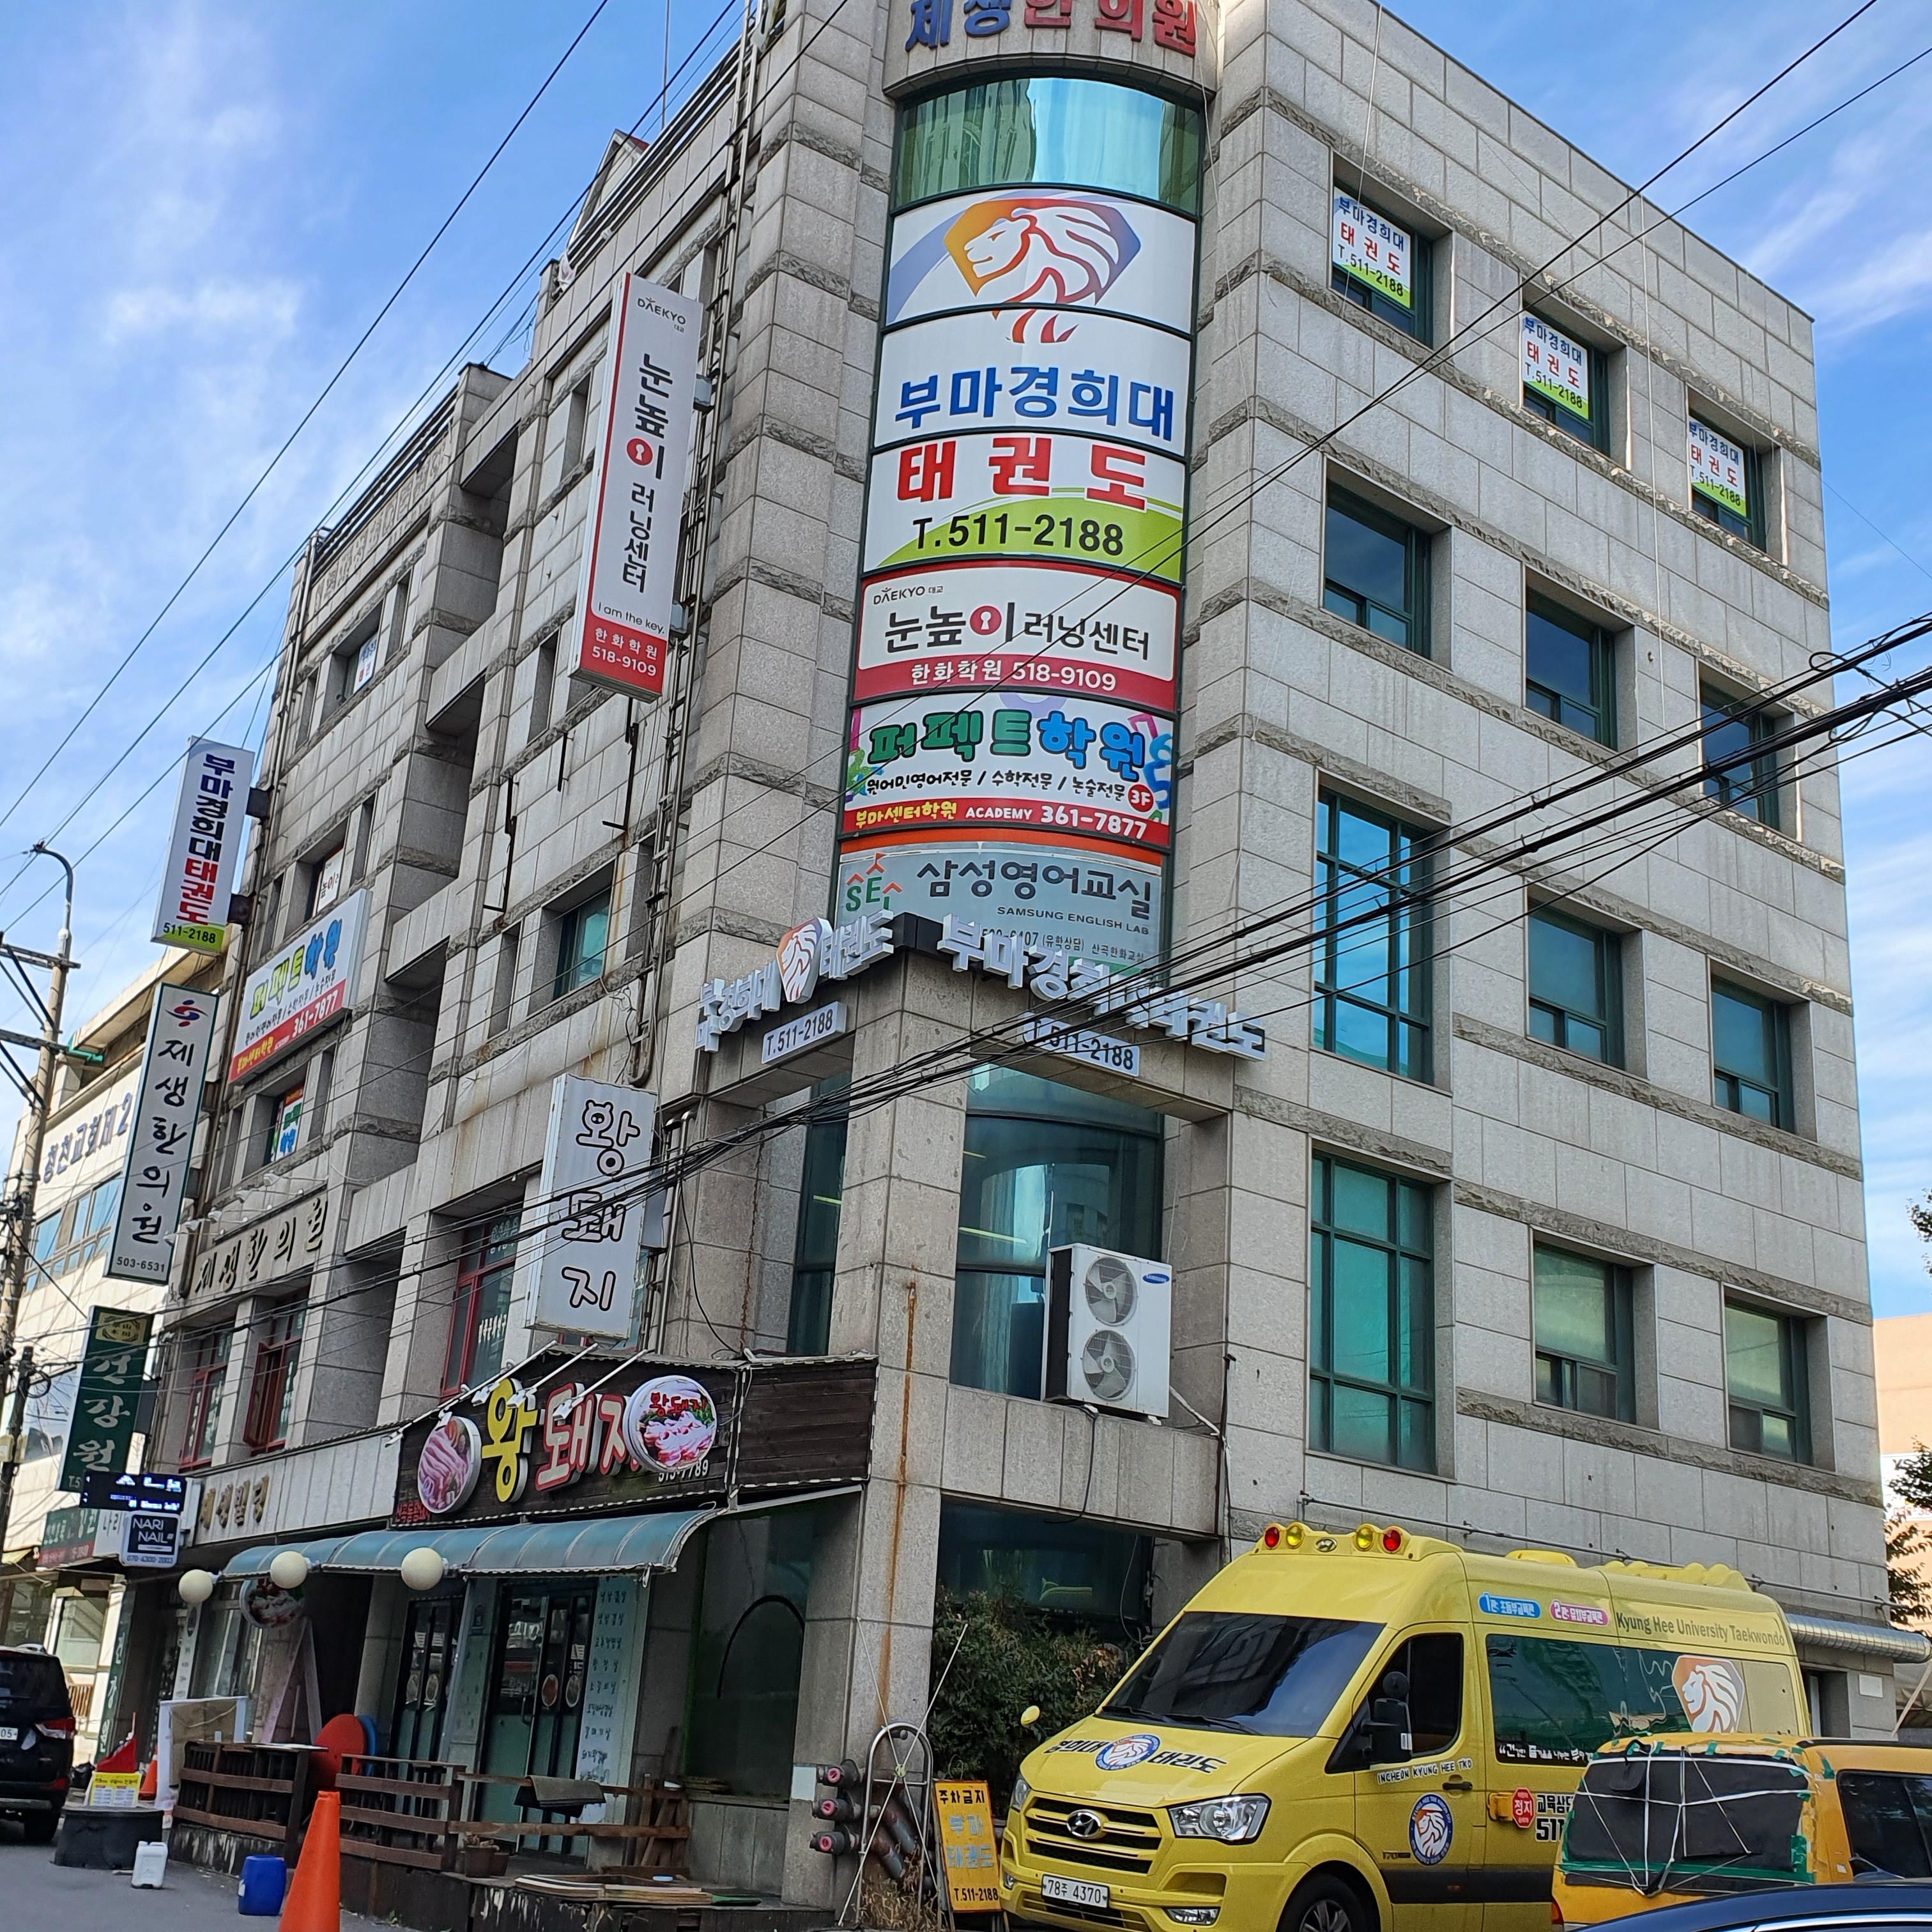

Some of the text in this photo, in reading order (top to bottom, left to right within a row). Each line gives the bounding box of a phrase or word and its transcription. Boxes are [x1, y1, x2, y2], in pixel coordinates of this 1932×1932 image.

[1338, 196, 1404, 253] 부마경희대
[1340, 221, 1401, 276] 태권도
[1338, 244, 1404, 297] T.511-2188
[638, 296, 686, 325] DAEKYO
[1524, 316, 1582, 367] 부마경희대
[1527, 341, 1580, 389] 태권도
[895, 366, 1174, 441] 부마경희대
[1525, 362, 1583, 409] T.511-2188
[1689, 420, 1739, 466] 부마경희대
[896, 436, 1147, 512] 태권도
[1690, 443, 1738, 487] 태권도
[1690, 464, 1741, 507] T.511-2188
[912, 512, 1124, 556] T.511-2188
[873, 586, 926, 605] DAEKYO
[604, 606, 622, 619] am
[625, 613, 643, 625] the
[645, 618, 665, 636] key.
[592, 646, 657, 677] 518-9109
[595, 627, 658, 661] 한화학원
[911, 659, 1117, 692] 한화학원 518-9109
[866, 709, 1146, 783] 퍼펙트학원
[866, 769, 973, 796] 원어민영어전문
[992, 769, 1053, 790] 수학전문
[1071, 776, 1126, 802] 논술전문
[1130, 788, 1151, 806] 3F
[188, 753, 236, 863] 부마경희대
[855, 801, 1148, 841] 부마센터학원 ACADEMY 361-7877
[176, 857, 219, 926] 태권도
[916, 859, 1151, 921] 삼성영어교실
[162, 922, 216, 944] 511-2188
[997, 907, 1149, 935] SAMSUNG ENGLISH LAB
[820, 908, 894, 981] 태권도
[292, 988, 339, 1038] 361-7877
[767, 1008, 833, 1057] T.511-2188
[131, 1039, 194, 1245] 제생한의원
[561, 1099, 641, 1312] 왕돼지
[116, 1256, 166, 1273] 503-6531
[133, 1517, 164, 1530] NARI
[139, 1530, 168, 1544] NAIL
[1616, 1612, 1785, 1647] Kyung Hee University Taekwondo
[1147, 1751, 1228, 1774] 태권도
[1378, 1770, 1409, 1784] INCHEON
[1413, 1764, 1438, 1777] KYUNG
[1441, 1762, 1455, 1773] HEE
[939, 1790, 985, 1805] 주차금지
[1514, 1799, 1533, 1816] 정지
[949, 1814, 984, 1837] 부마
[946, 1844, 994, 1869] 태권도
[953, 1887, 999, 1901] T.511-2188
[1048, 1879, 1101, 1904] 78주 4370
